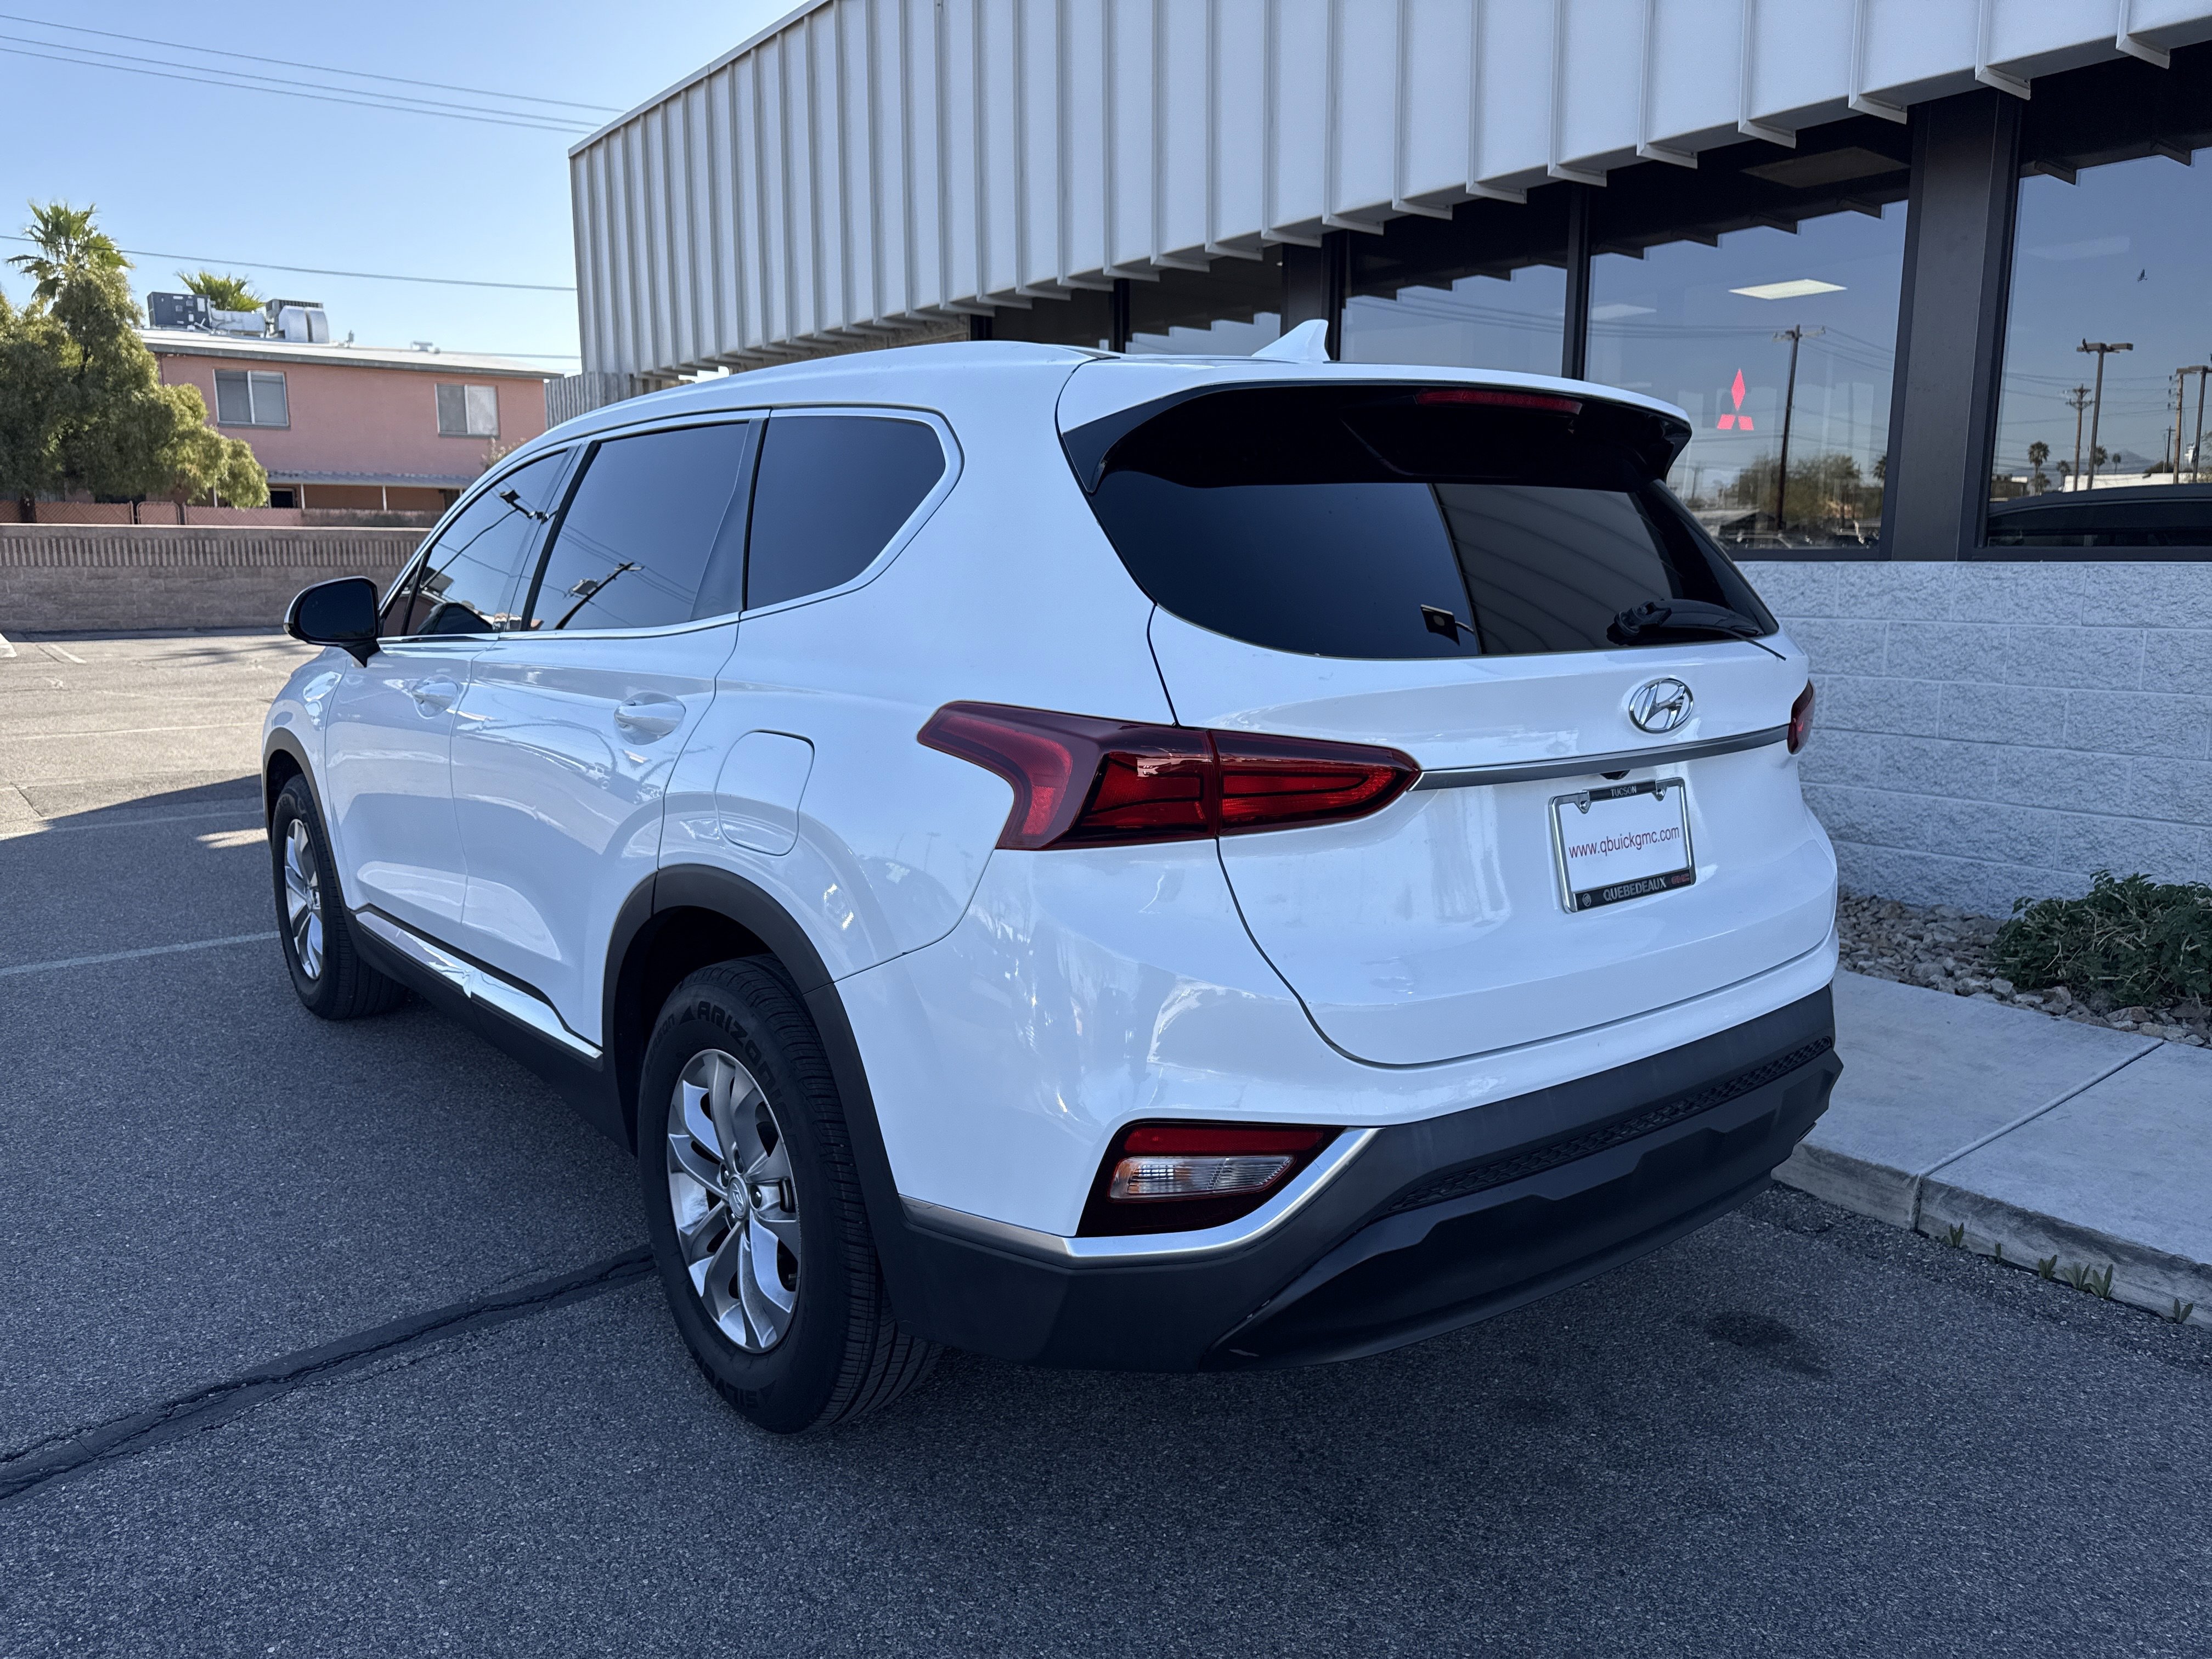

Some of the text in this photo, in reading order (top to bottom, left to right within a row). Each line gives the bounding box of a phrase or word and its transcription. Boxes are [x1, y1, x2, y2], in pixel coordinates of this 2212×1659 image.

[1610, 786, 1637, 797] TUCSON
[1568, 827, 1680, 858] www.qbuickgmc.com
[1602, 876, 1667, 901] QUEBEDEAUX
